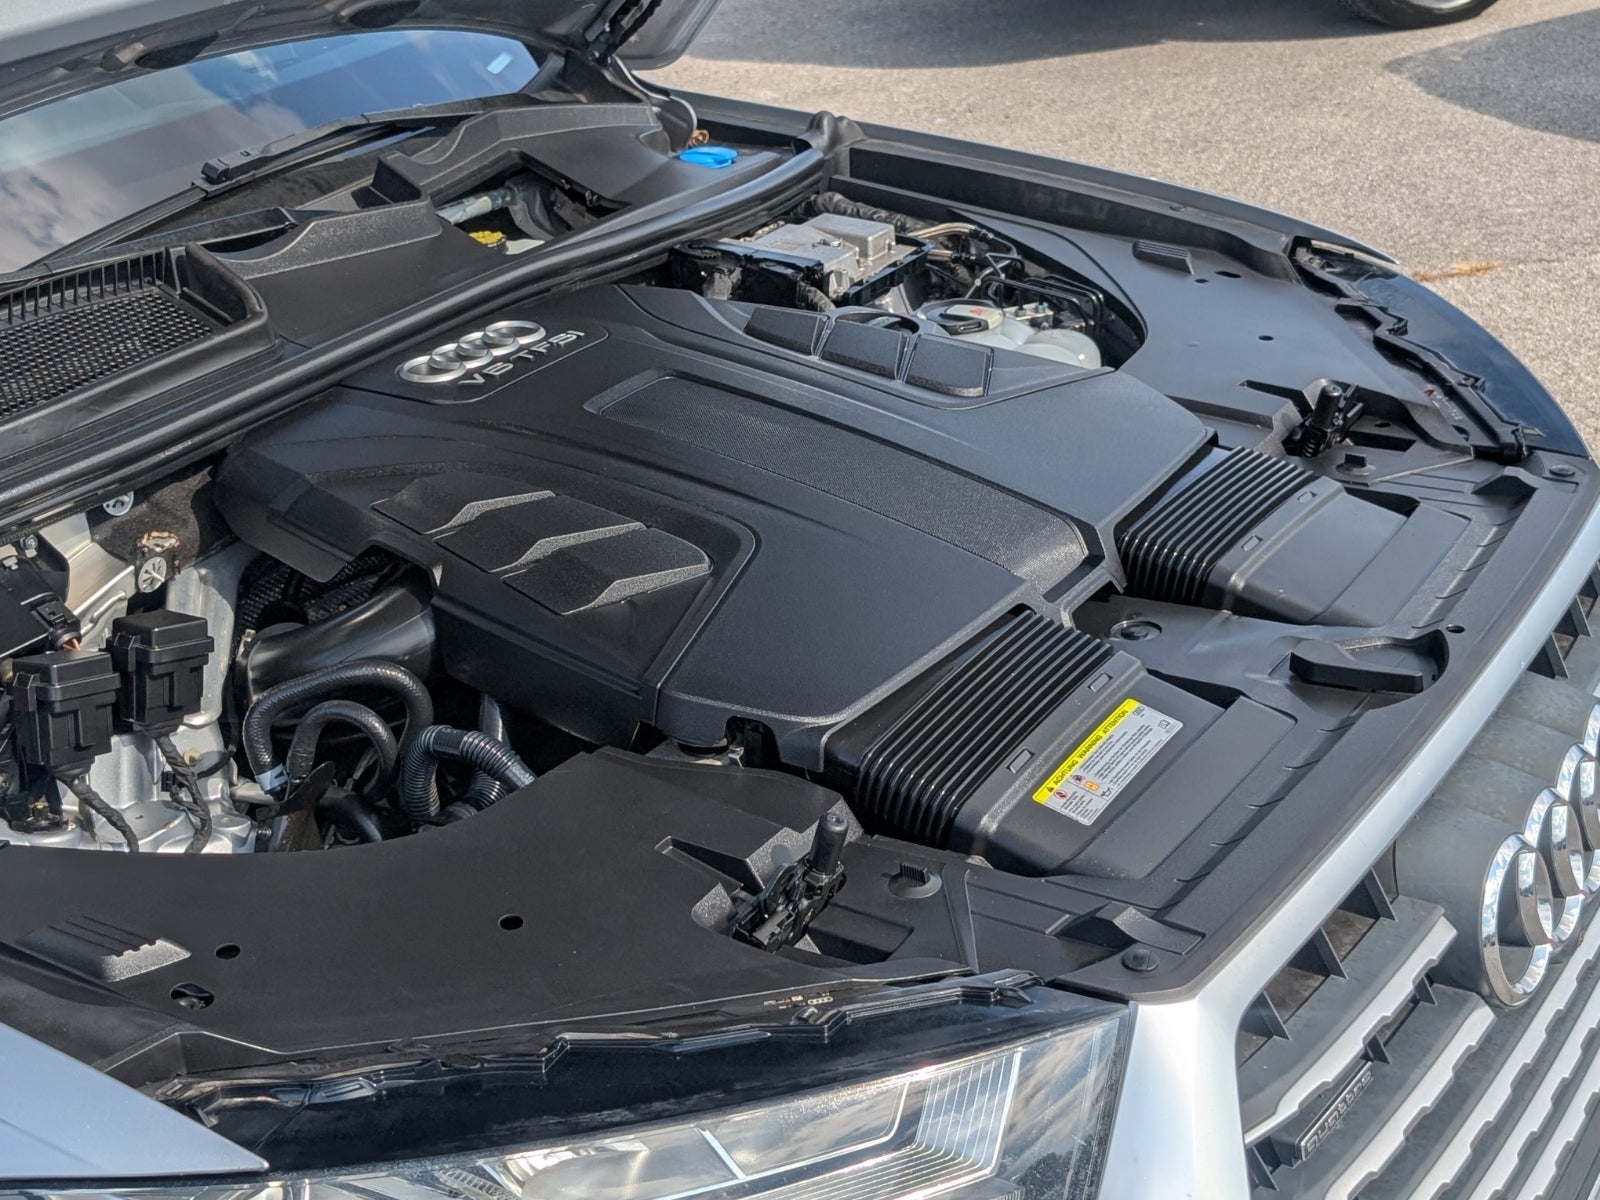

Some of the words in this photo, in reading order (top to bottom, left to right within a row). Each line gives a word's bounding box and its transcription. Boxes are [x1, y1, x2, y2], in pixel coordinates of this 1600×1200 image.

[457, 361, 514, 386] V6
[509, 329, 586, 362] TFSI
[1053, 760, 1079, 786] ACHTUNG
[1077, 735, 1103, 760] WARNING
[1101, 709, 1129, 735] ATTENTION
